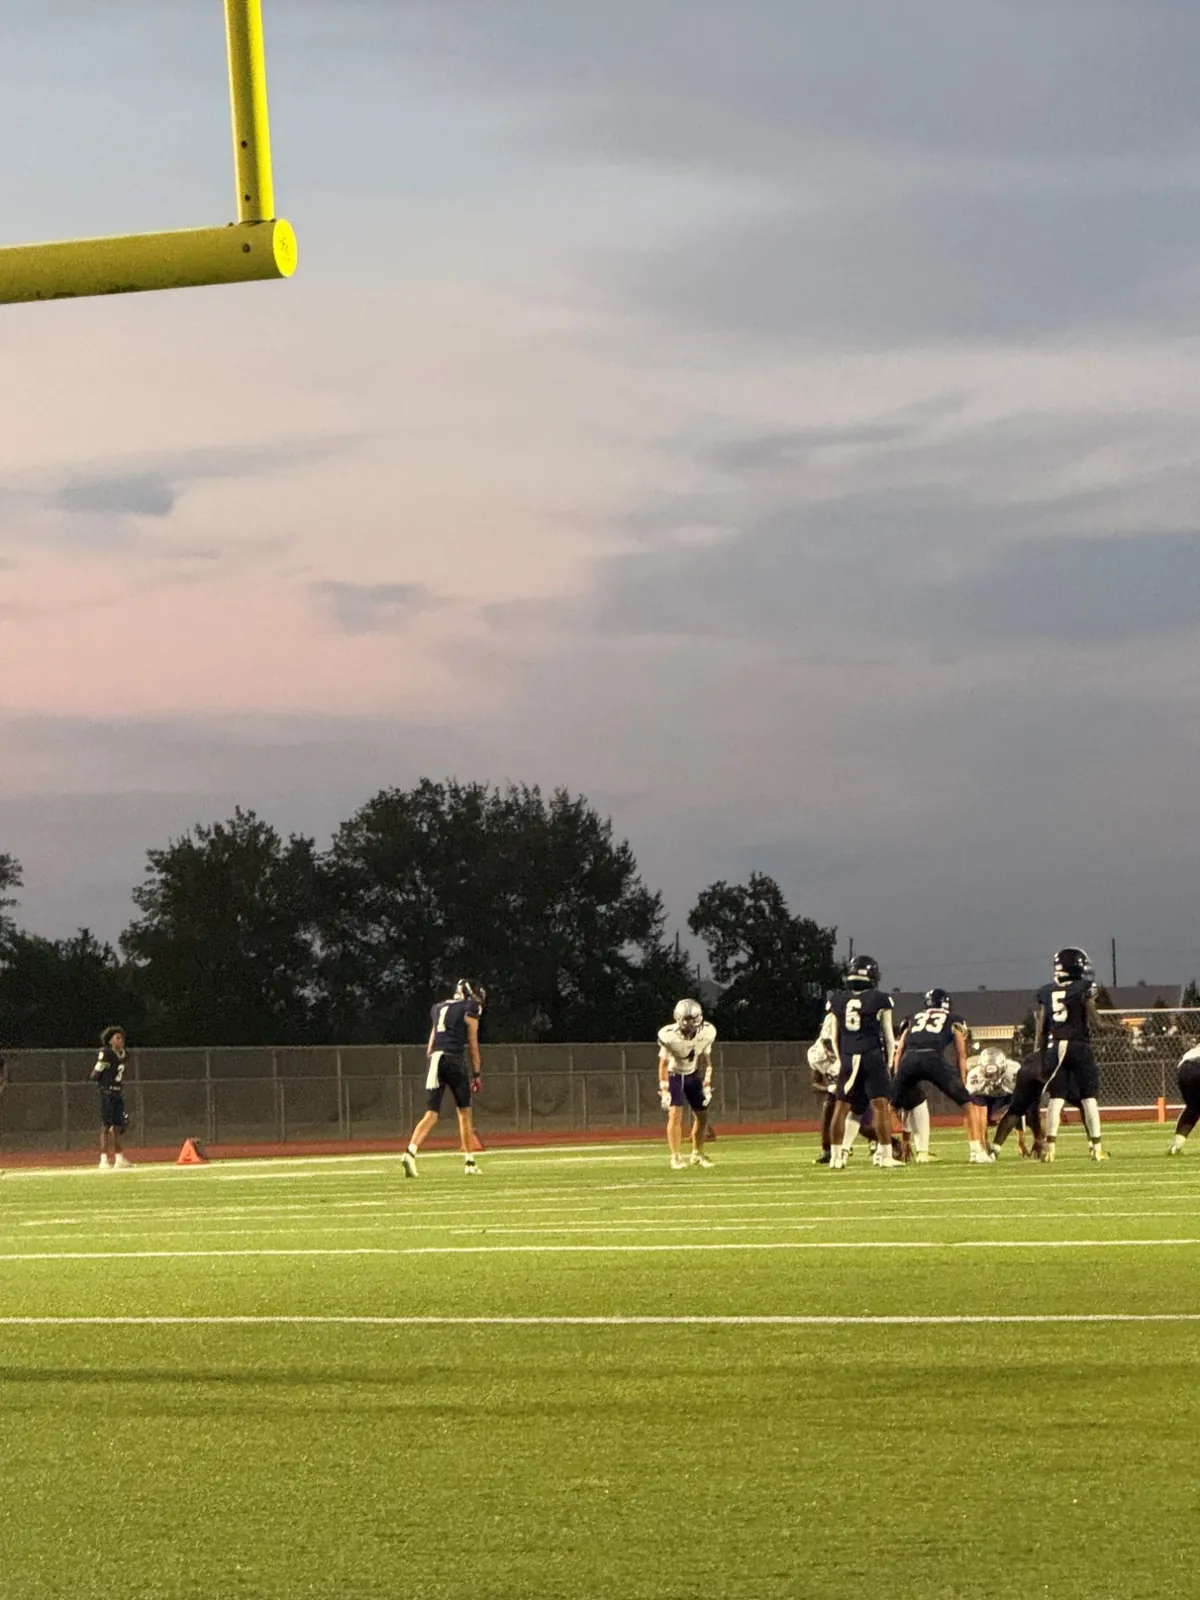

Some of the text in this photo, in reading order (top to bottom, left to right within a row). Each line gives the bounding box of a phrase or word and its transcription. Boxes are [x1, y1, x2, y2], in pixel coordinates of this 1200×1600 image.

[437, 1005, 449, 1032] 1
[845, 999, 862, 1031] 6
[1051, 990, 1069, 1022] 5
[911, 1012, 947, 1034] 33
